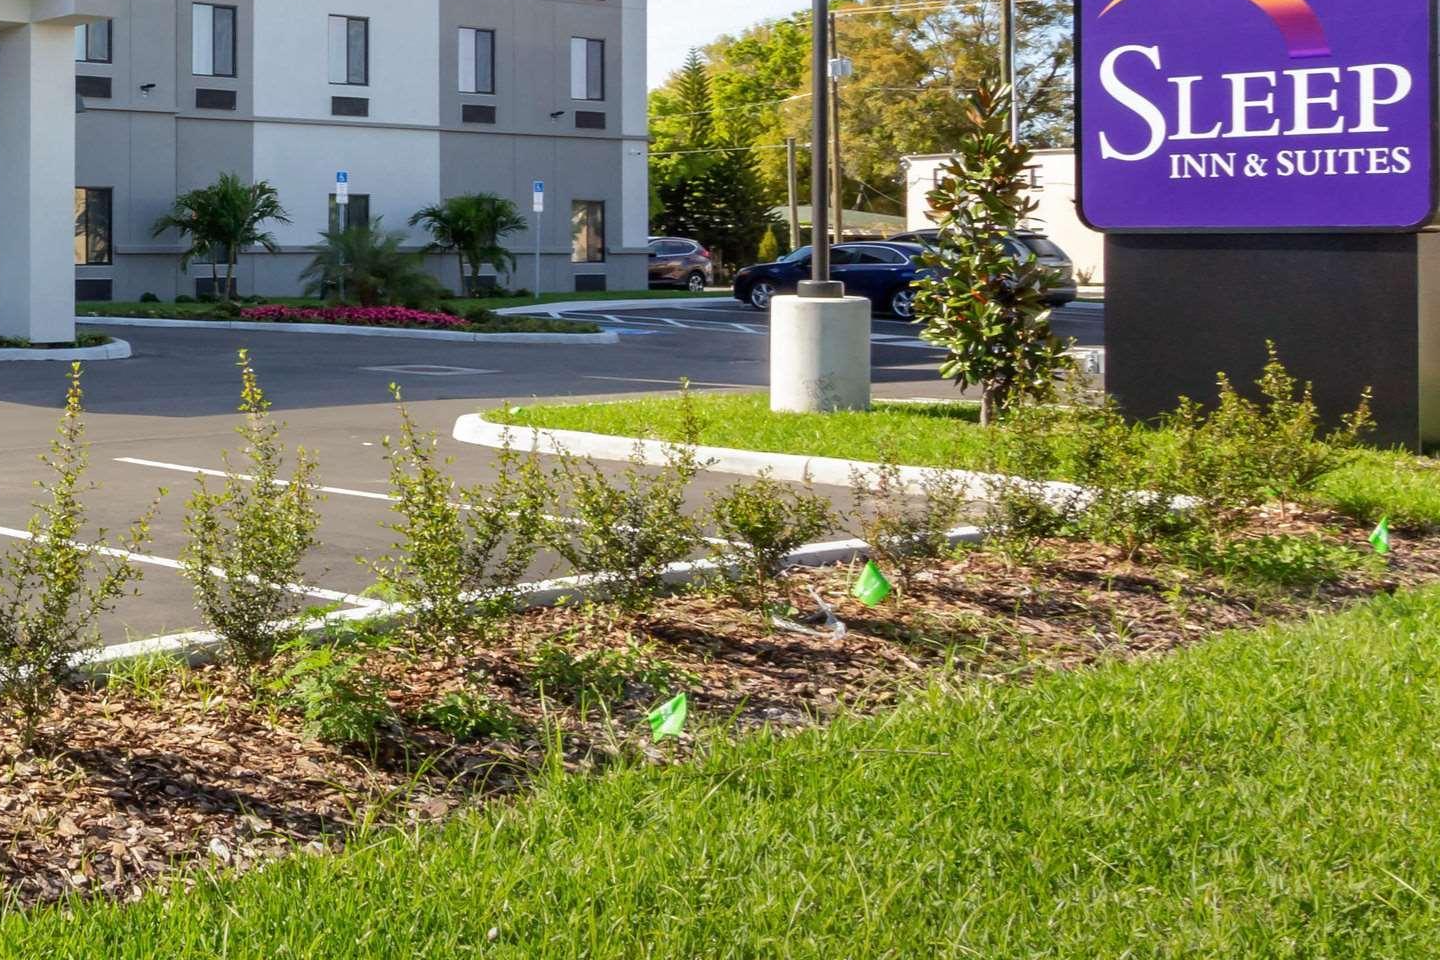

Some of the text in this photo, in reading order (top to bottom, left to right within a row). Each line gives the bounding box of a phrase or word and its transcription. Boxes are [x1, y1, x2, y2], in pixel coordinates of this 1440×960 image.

[1098, 44, 1412, 162] SLEEP
[1168, 146, 1412, 179] INN & SUITES
